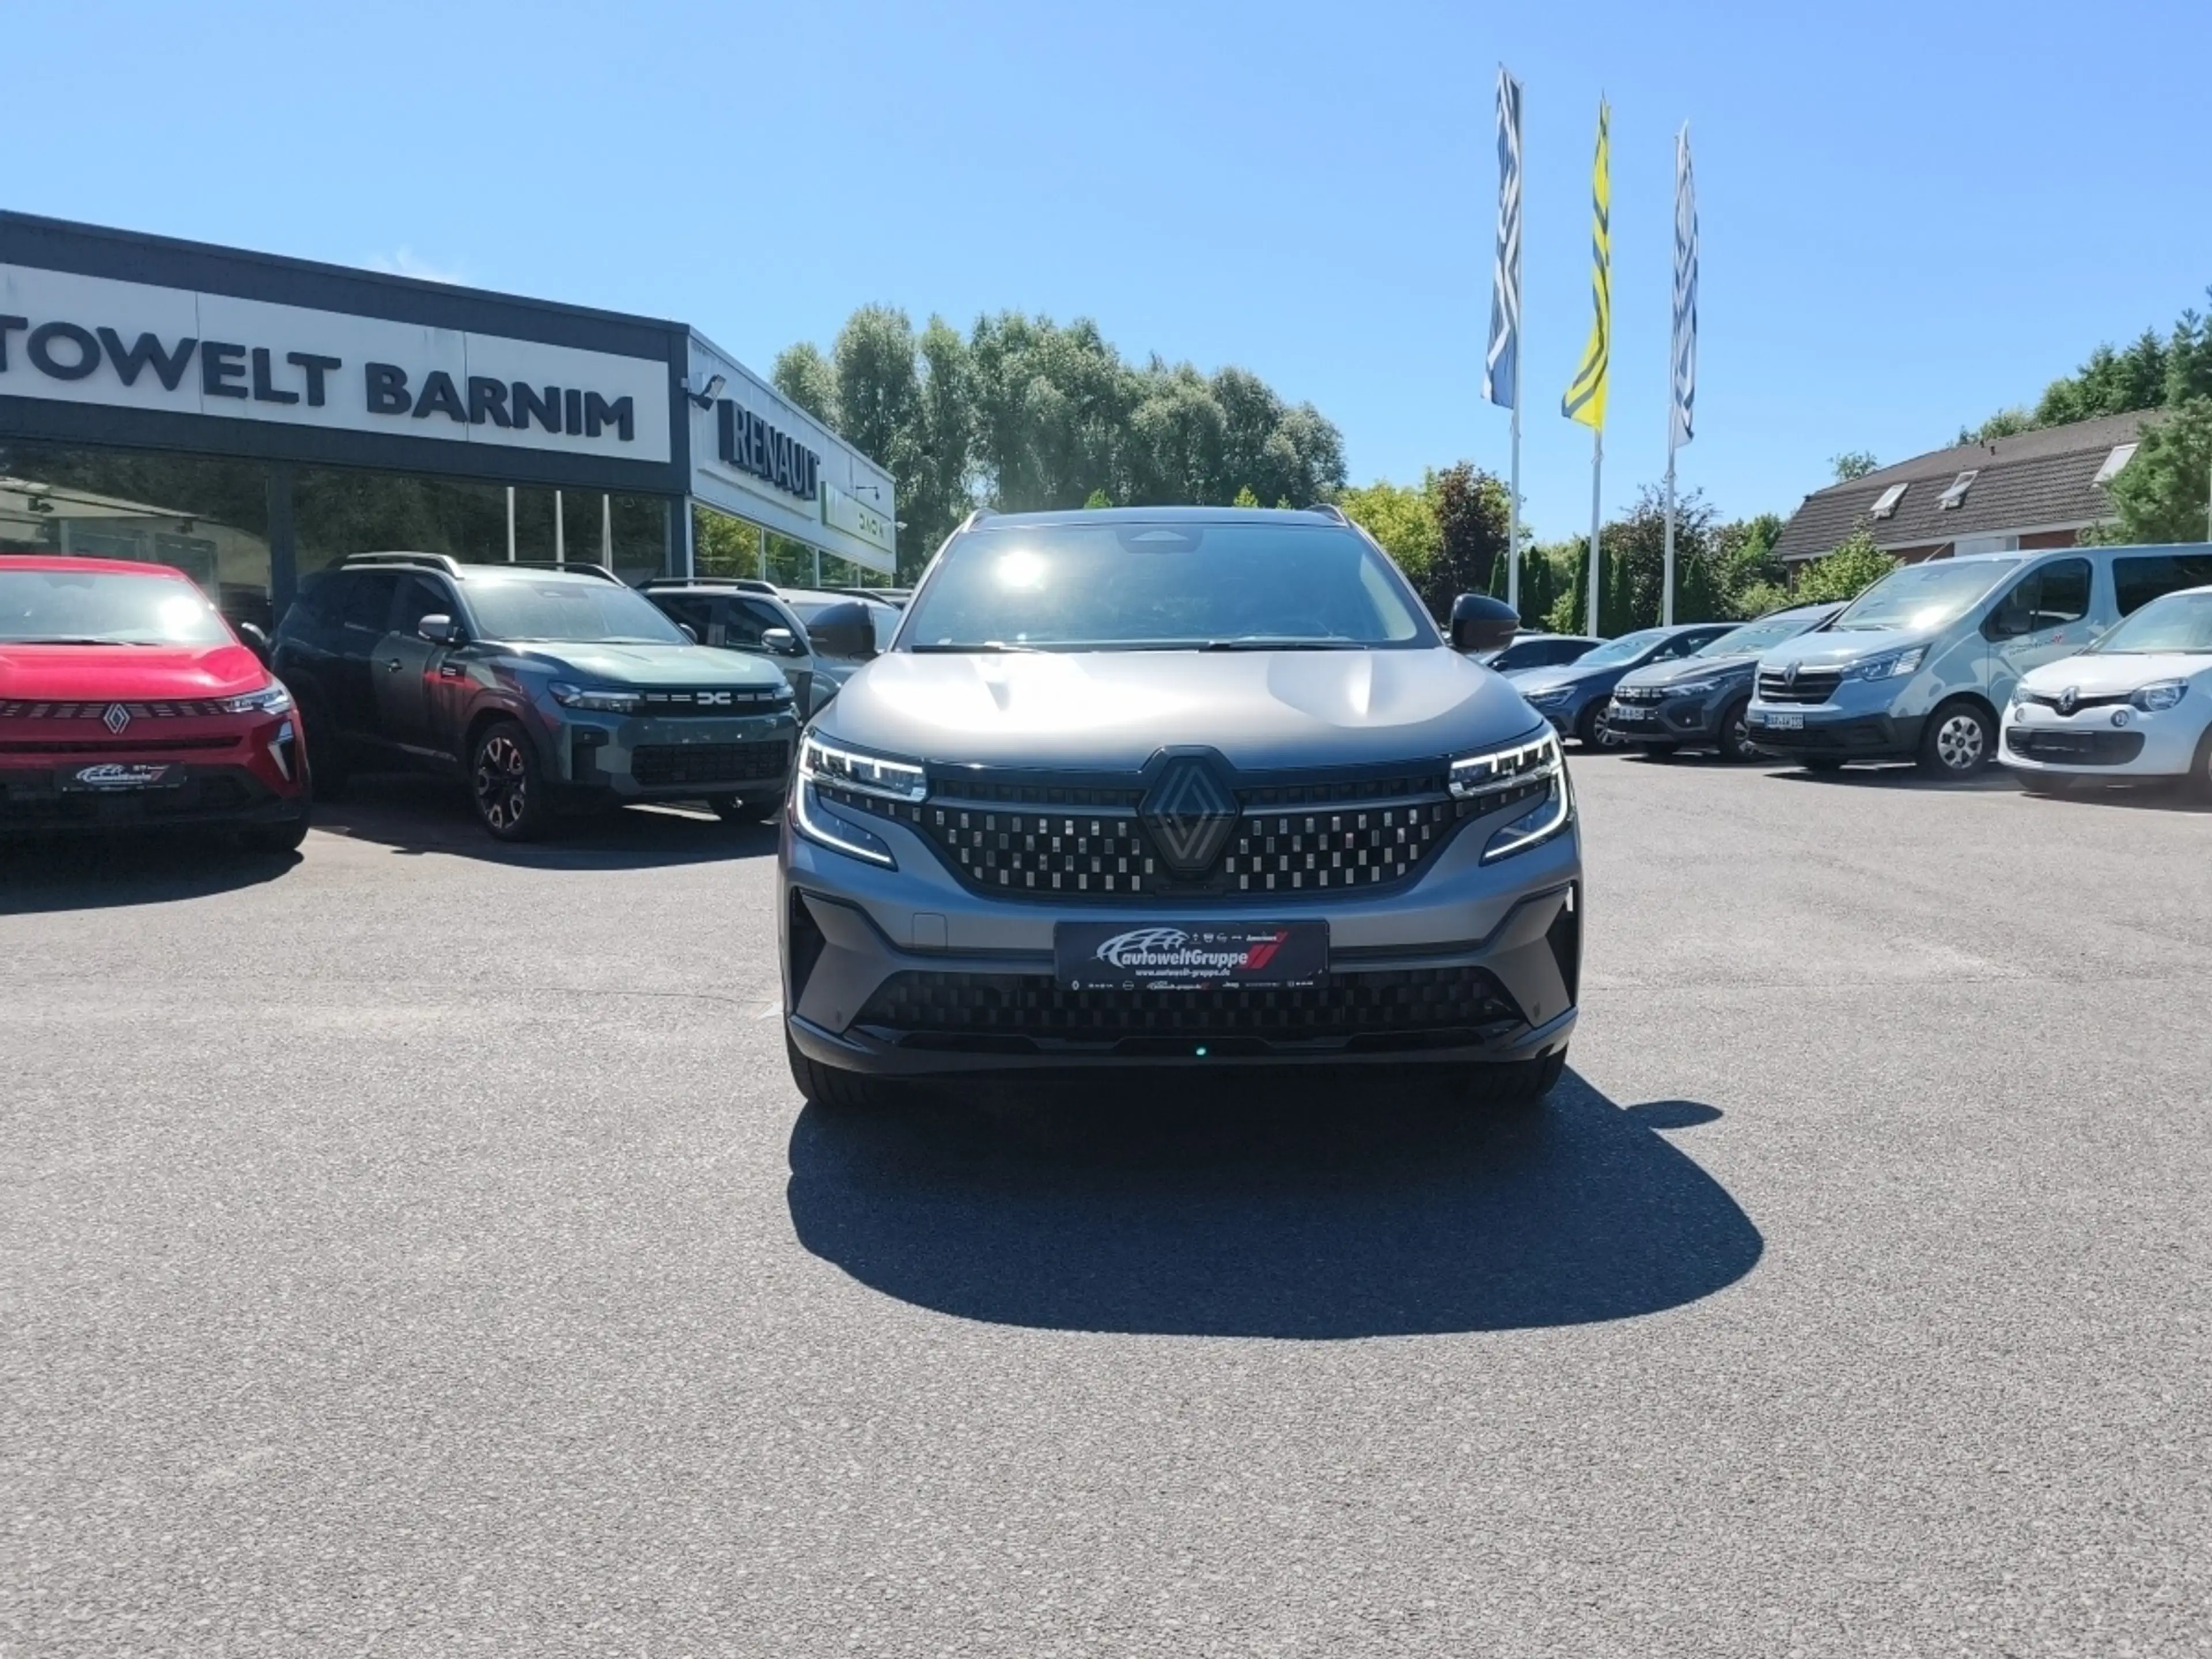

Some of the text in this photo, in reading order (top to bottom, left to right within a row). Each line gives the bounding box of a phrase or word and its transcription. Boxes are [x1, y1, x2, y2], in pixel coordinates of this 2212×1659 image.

[365, 350, 634, 441] BARNIM
[718, 399, 820, 501] RENAULT
[1122, 948, 1248, 968] autoweltGruppe
